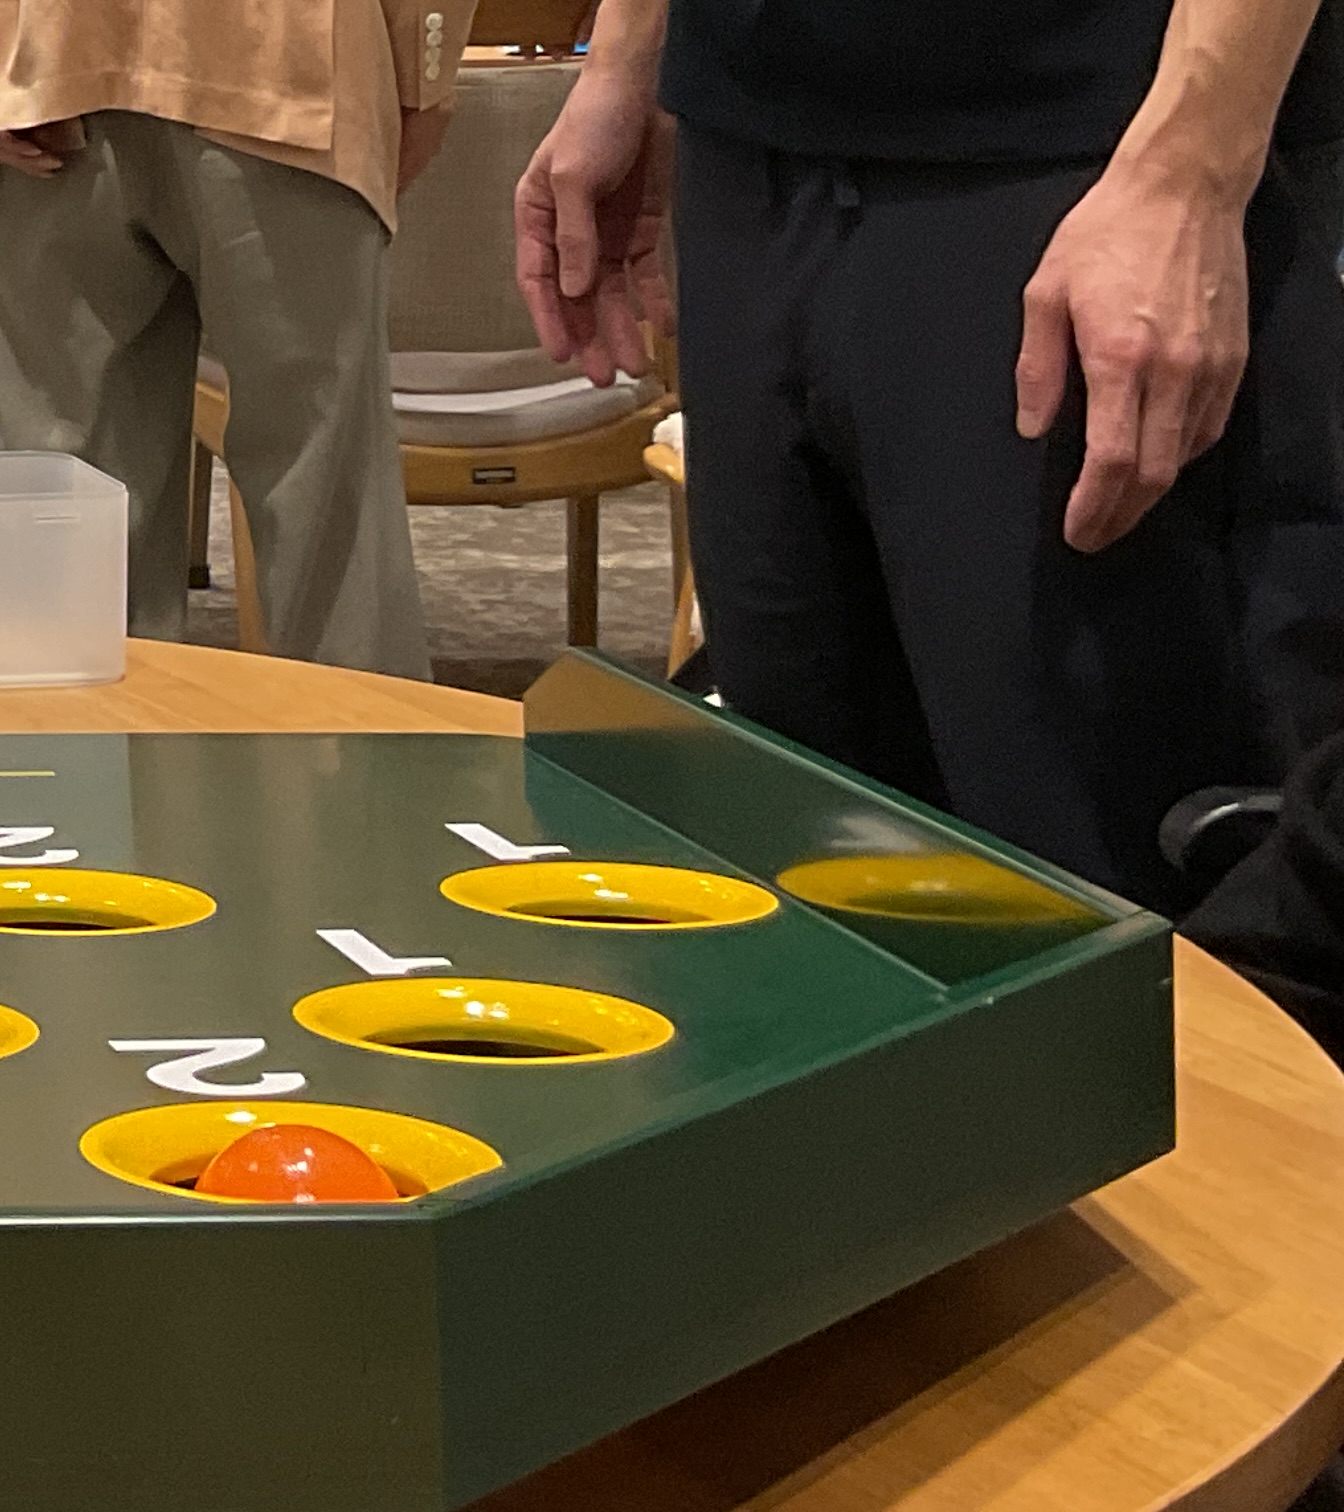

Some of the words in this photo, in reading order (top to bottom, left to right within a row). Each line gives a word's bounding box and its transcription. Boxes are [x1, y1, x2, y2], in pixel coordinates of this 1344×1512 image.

[444, 823, 572, 861] 1
[315, 928, 453, 976] 1
[107, 1037, 306, 1097] 2
